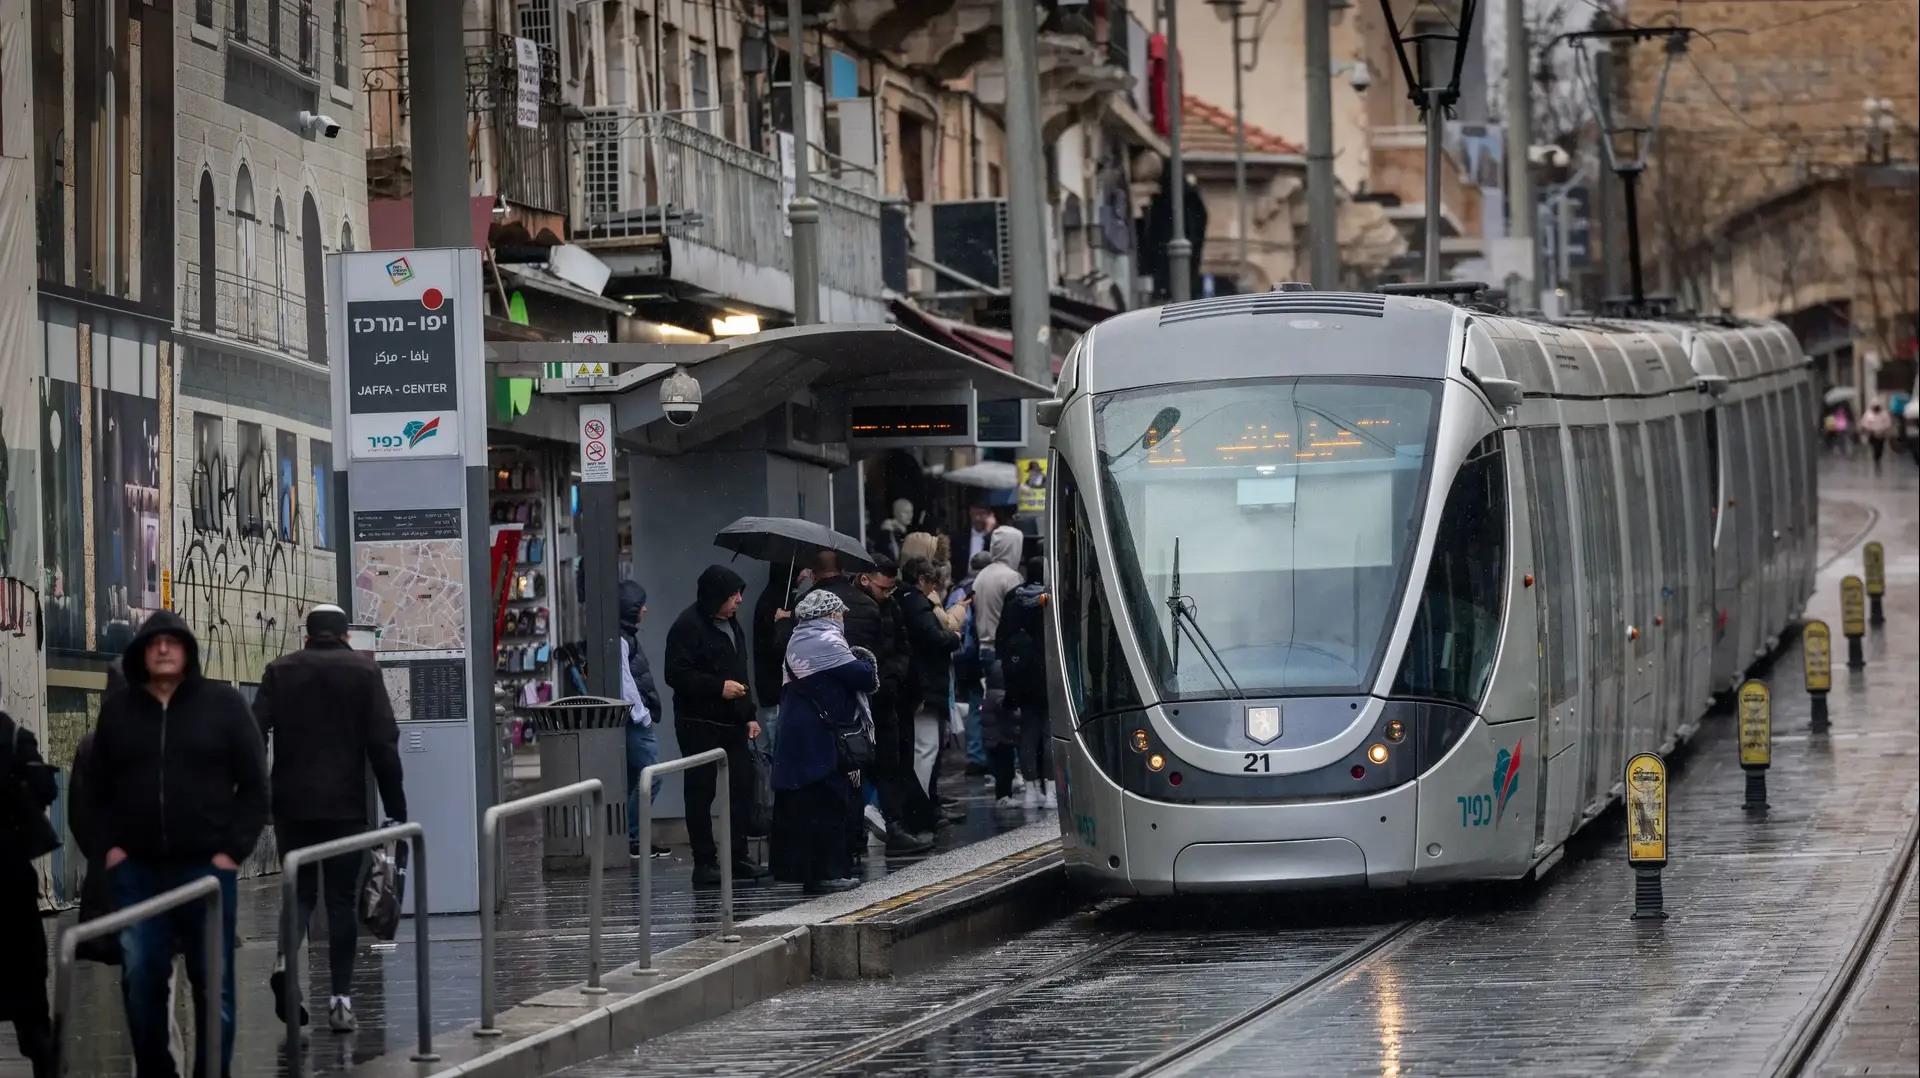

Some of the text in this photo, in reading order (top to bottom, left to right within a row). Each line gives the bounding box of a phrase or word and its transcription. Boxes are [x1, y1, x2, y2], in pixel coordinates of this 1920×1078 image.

[353, 316, 404, 333] מרכז
[420, 315, 447, 330] יפו
[373, 351, 398, 365] مركز
[410, 350, 429, 363] يافا
[357, 385, 393, 396] JAFFA
[402, 383, 448, 394] CENTER
[367, 436, 403, 448] כפיר
[1243, 752, 1270, 773] 21
[1457, 794, 1492, 827] כפיר
